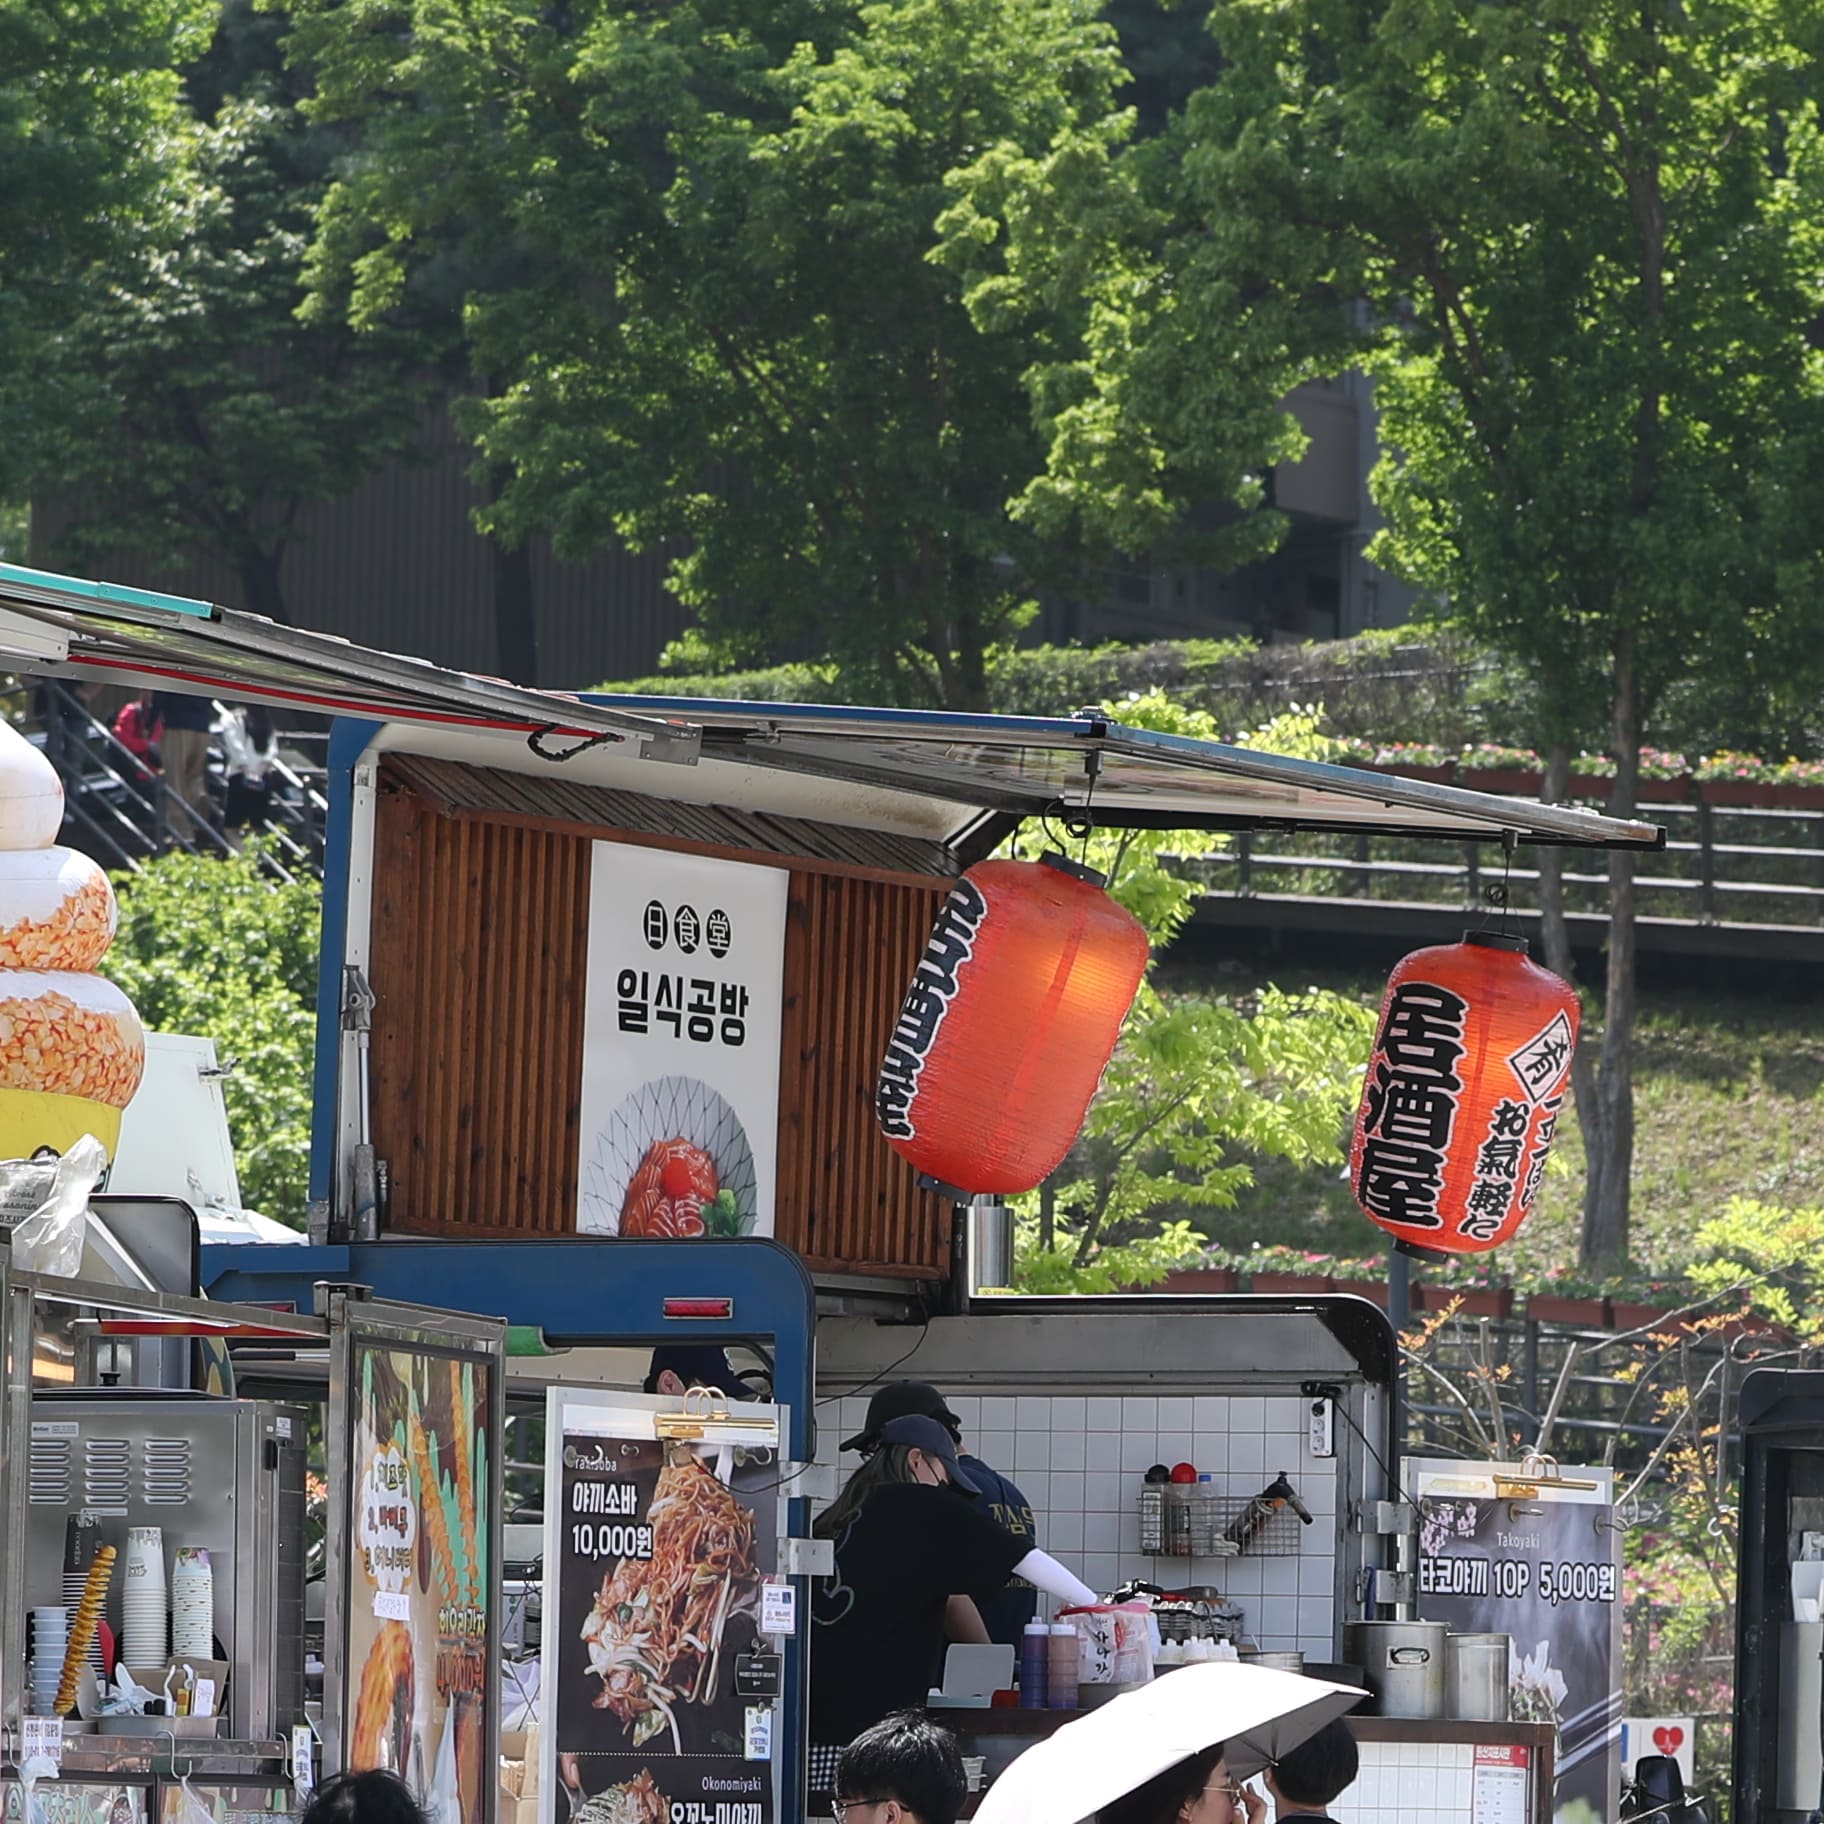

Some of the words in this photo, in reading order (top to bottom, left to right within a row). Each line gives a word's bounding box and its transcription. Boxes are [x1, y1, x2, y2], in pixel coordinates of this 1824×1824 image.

[643, 899, 731, 960] 日食堂
[616, 968, 749, 1047] 일식공방
[1359, 981, 1468, 1229] 居酒屋
[573, 1481, 638, 1515] 야끼소바
[572, 1524, 653, 1561] 10,000원
[1497, 1532, 1541, 1550] Takoyaki
[1420, 1558, 1489, 1595] 타코야끼
[1494, 1561, 1530, 1597] 10P
[1540, 1563, 1616, 1605] 5,000원
[701, 1776, 762, 1792] Okonomiyaki
